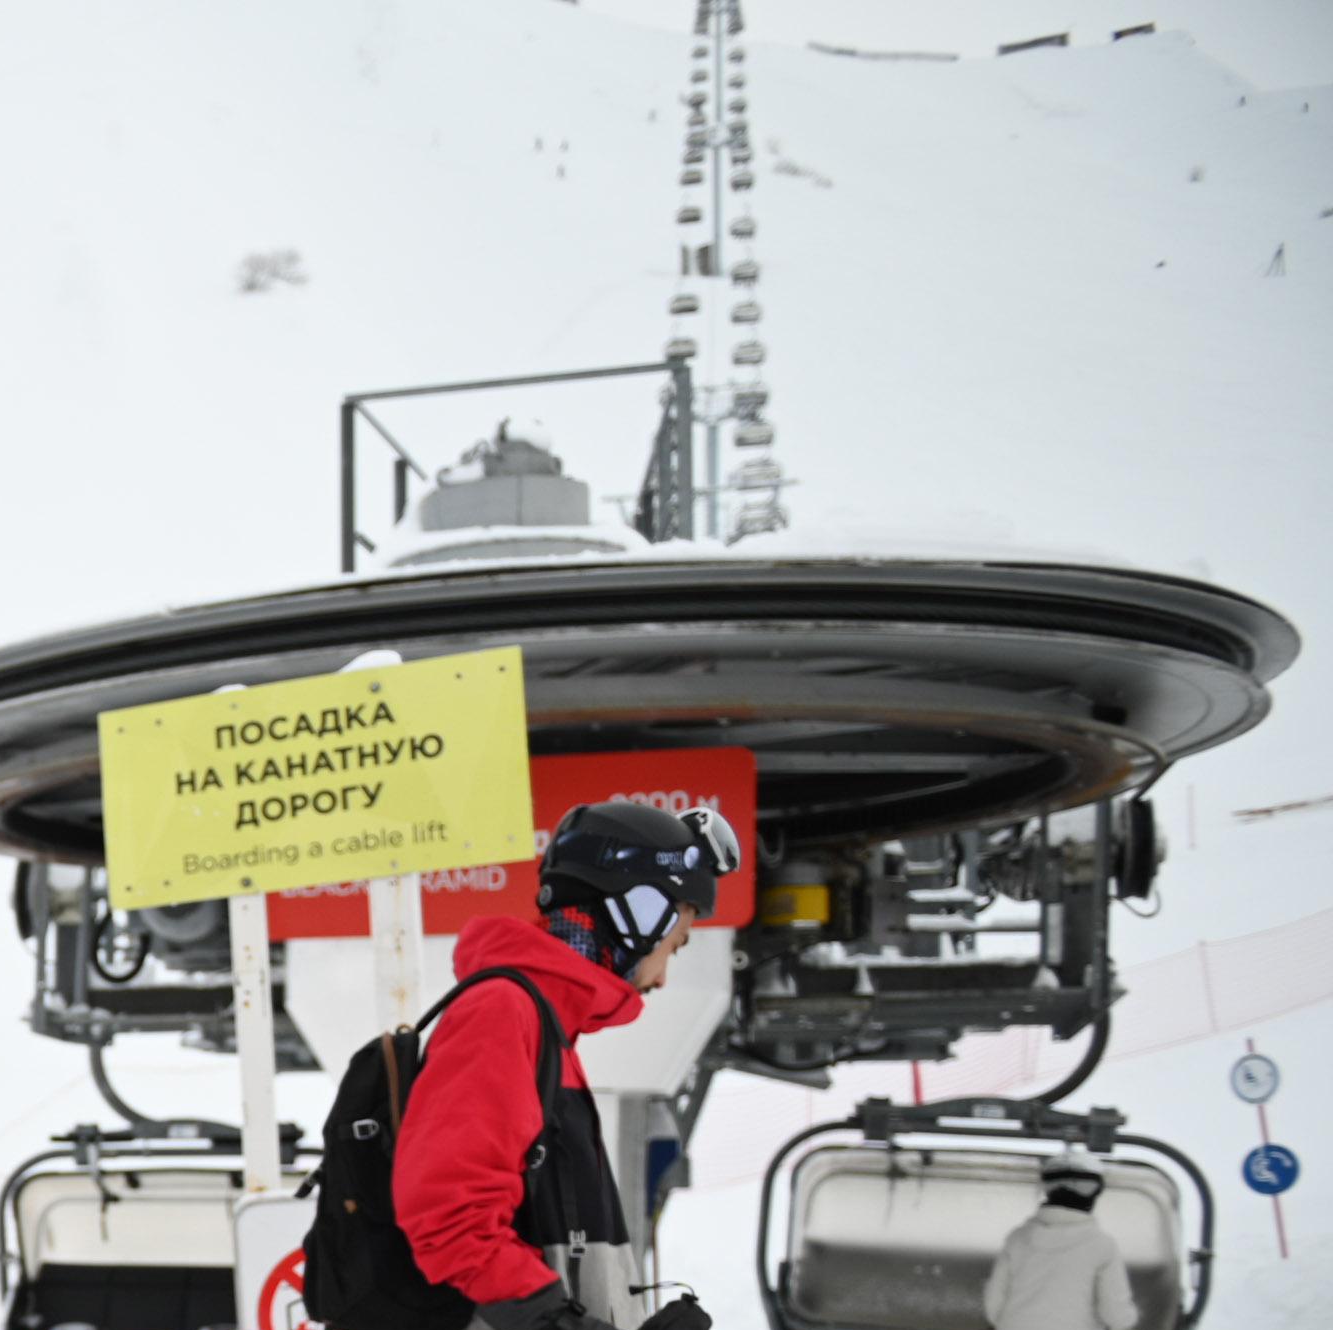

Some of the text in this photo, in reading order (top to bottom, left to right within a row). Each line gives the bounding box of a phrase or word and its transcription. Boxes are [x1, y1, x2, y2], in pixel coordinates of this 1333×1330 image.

[214, 701, 395, 750] ПОСАДКА
[175, 733, 444, 795] НА КАНАТНУЮ
[235, 781, 383, 830] ДОРОГУ
[183, 820, 448, 875] Boarding a cable lift
